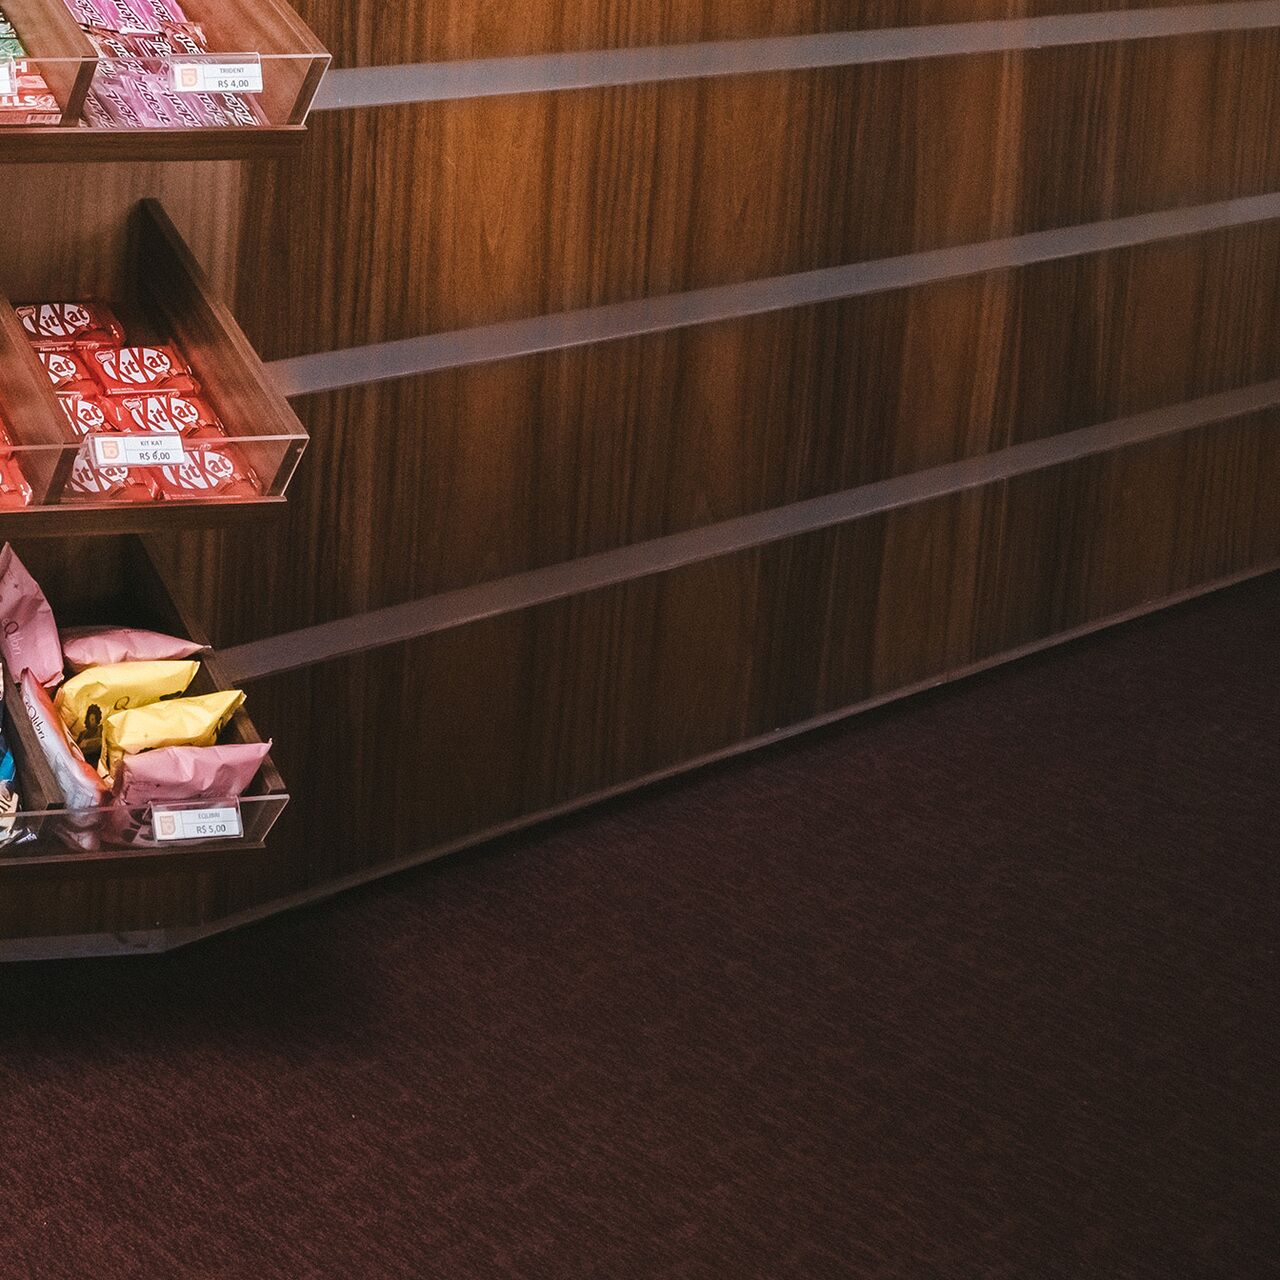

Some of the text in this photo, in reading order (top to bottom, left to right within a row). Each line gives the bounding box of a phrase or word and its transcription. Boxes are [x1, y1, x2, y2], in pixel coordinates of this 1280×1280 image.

[218, 78, 249, 88] R$ 4,00
[139, 450, 171, 461] R$ 6,00
[196, 824, 226, 835] R$ 5,00
